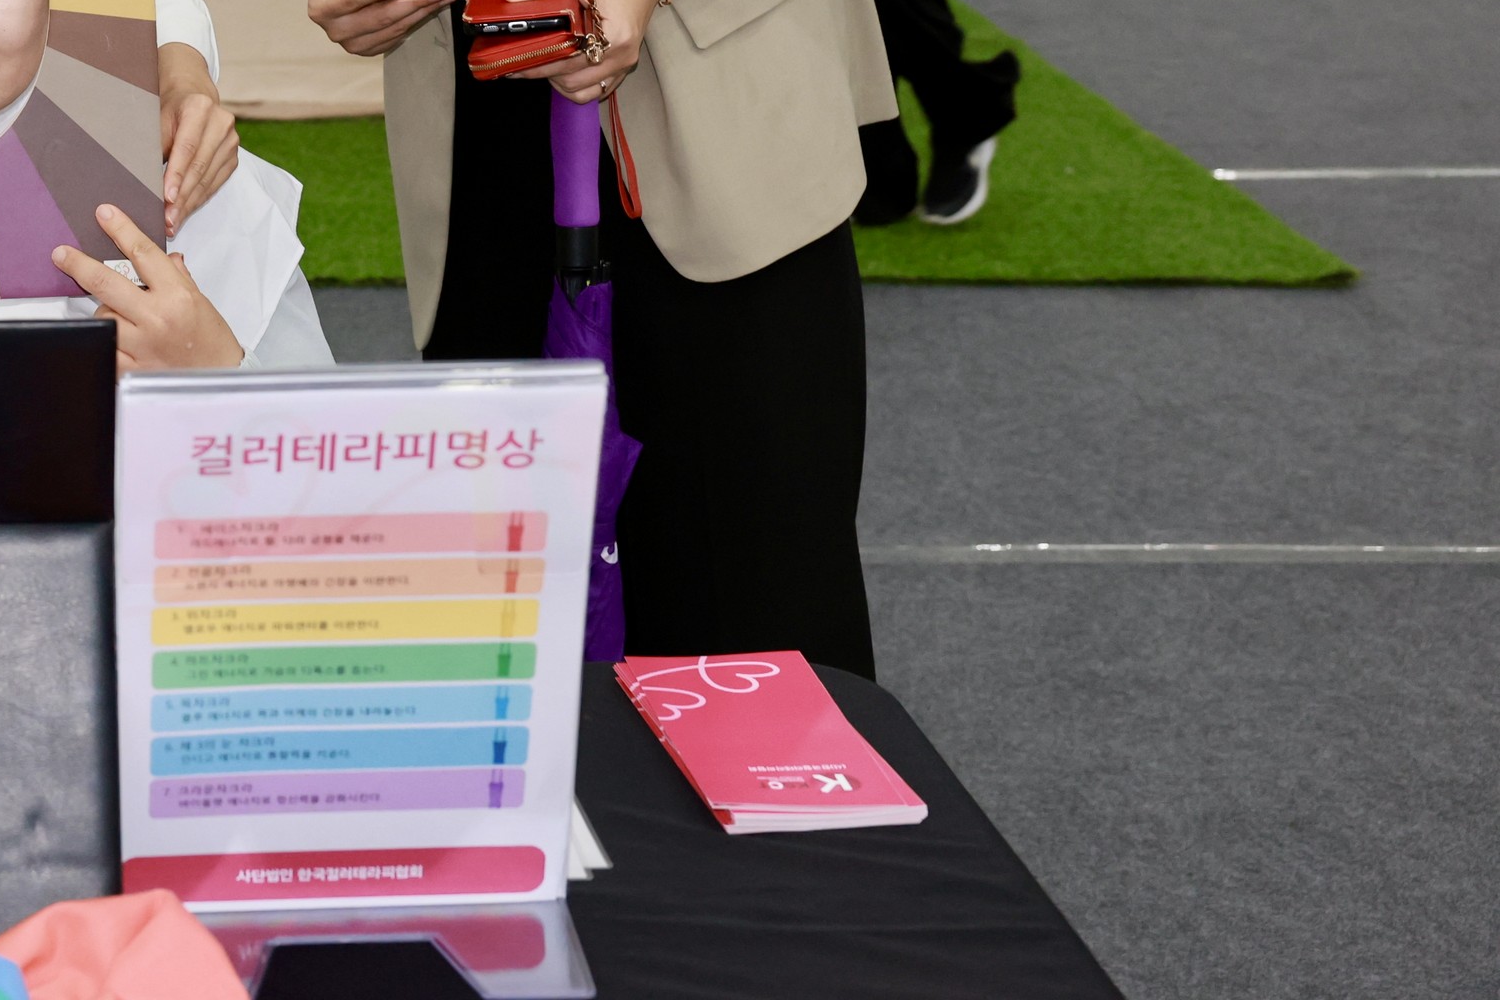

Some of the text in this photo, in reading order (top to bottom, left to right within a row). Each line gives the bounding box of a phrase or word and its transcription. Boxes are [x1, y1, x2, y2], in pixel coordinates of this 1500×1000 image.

[191, 428, 545, 476] 컬러테라피명상
[236, 864, 424, 884] 사단법인 한국컬러테라피협회
